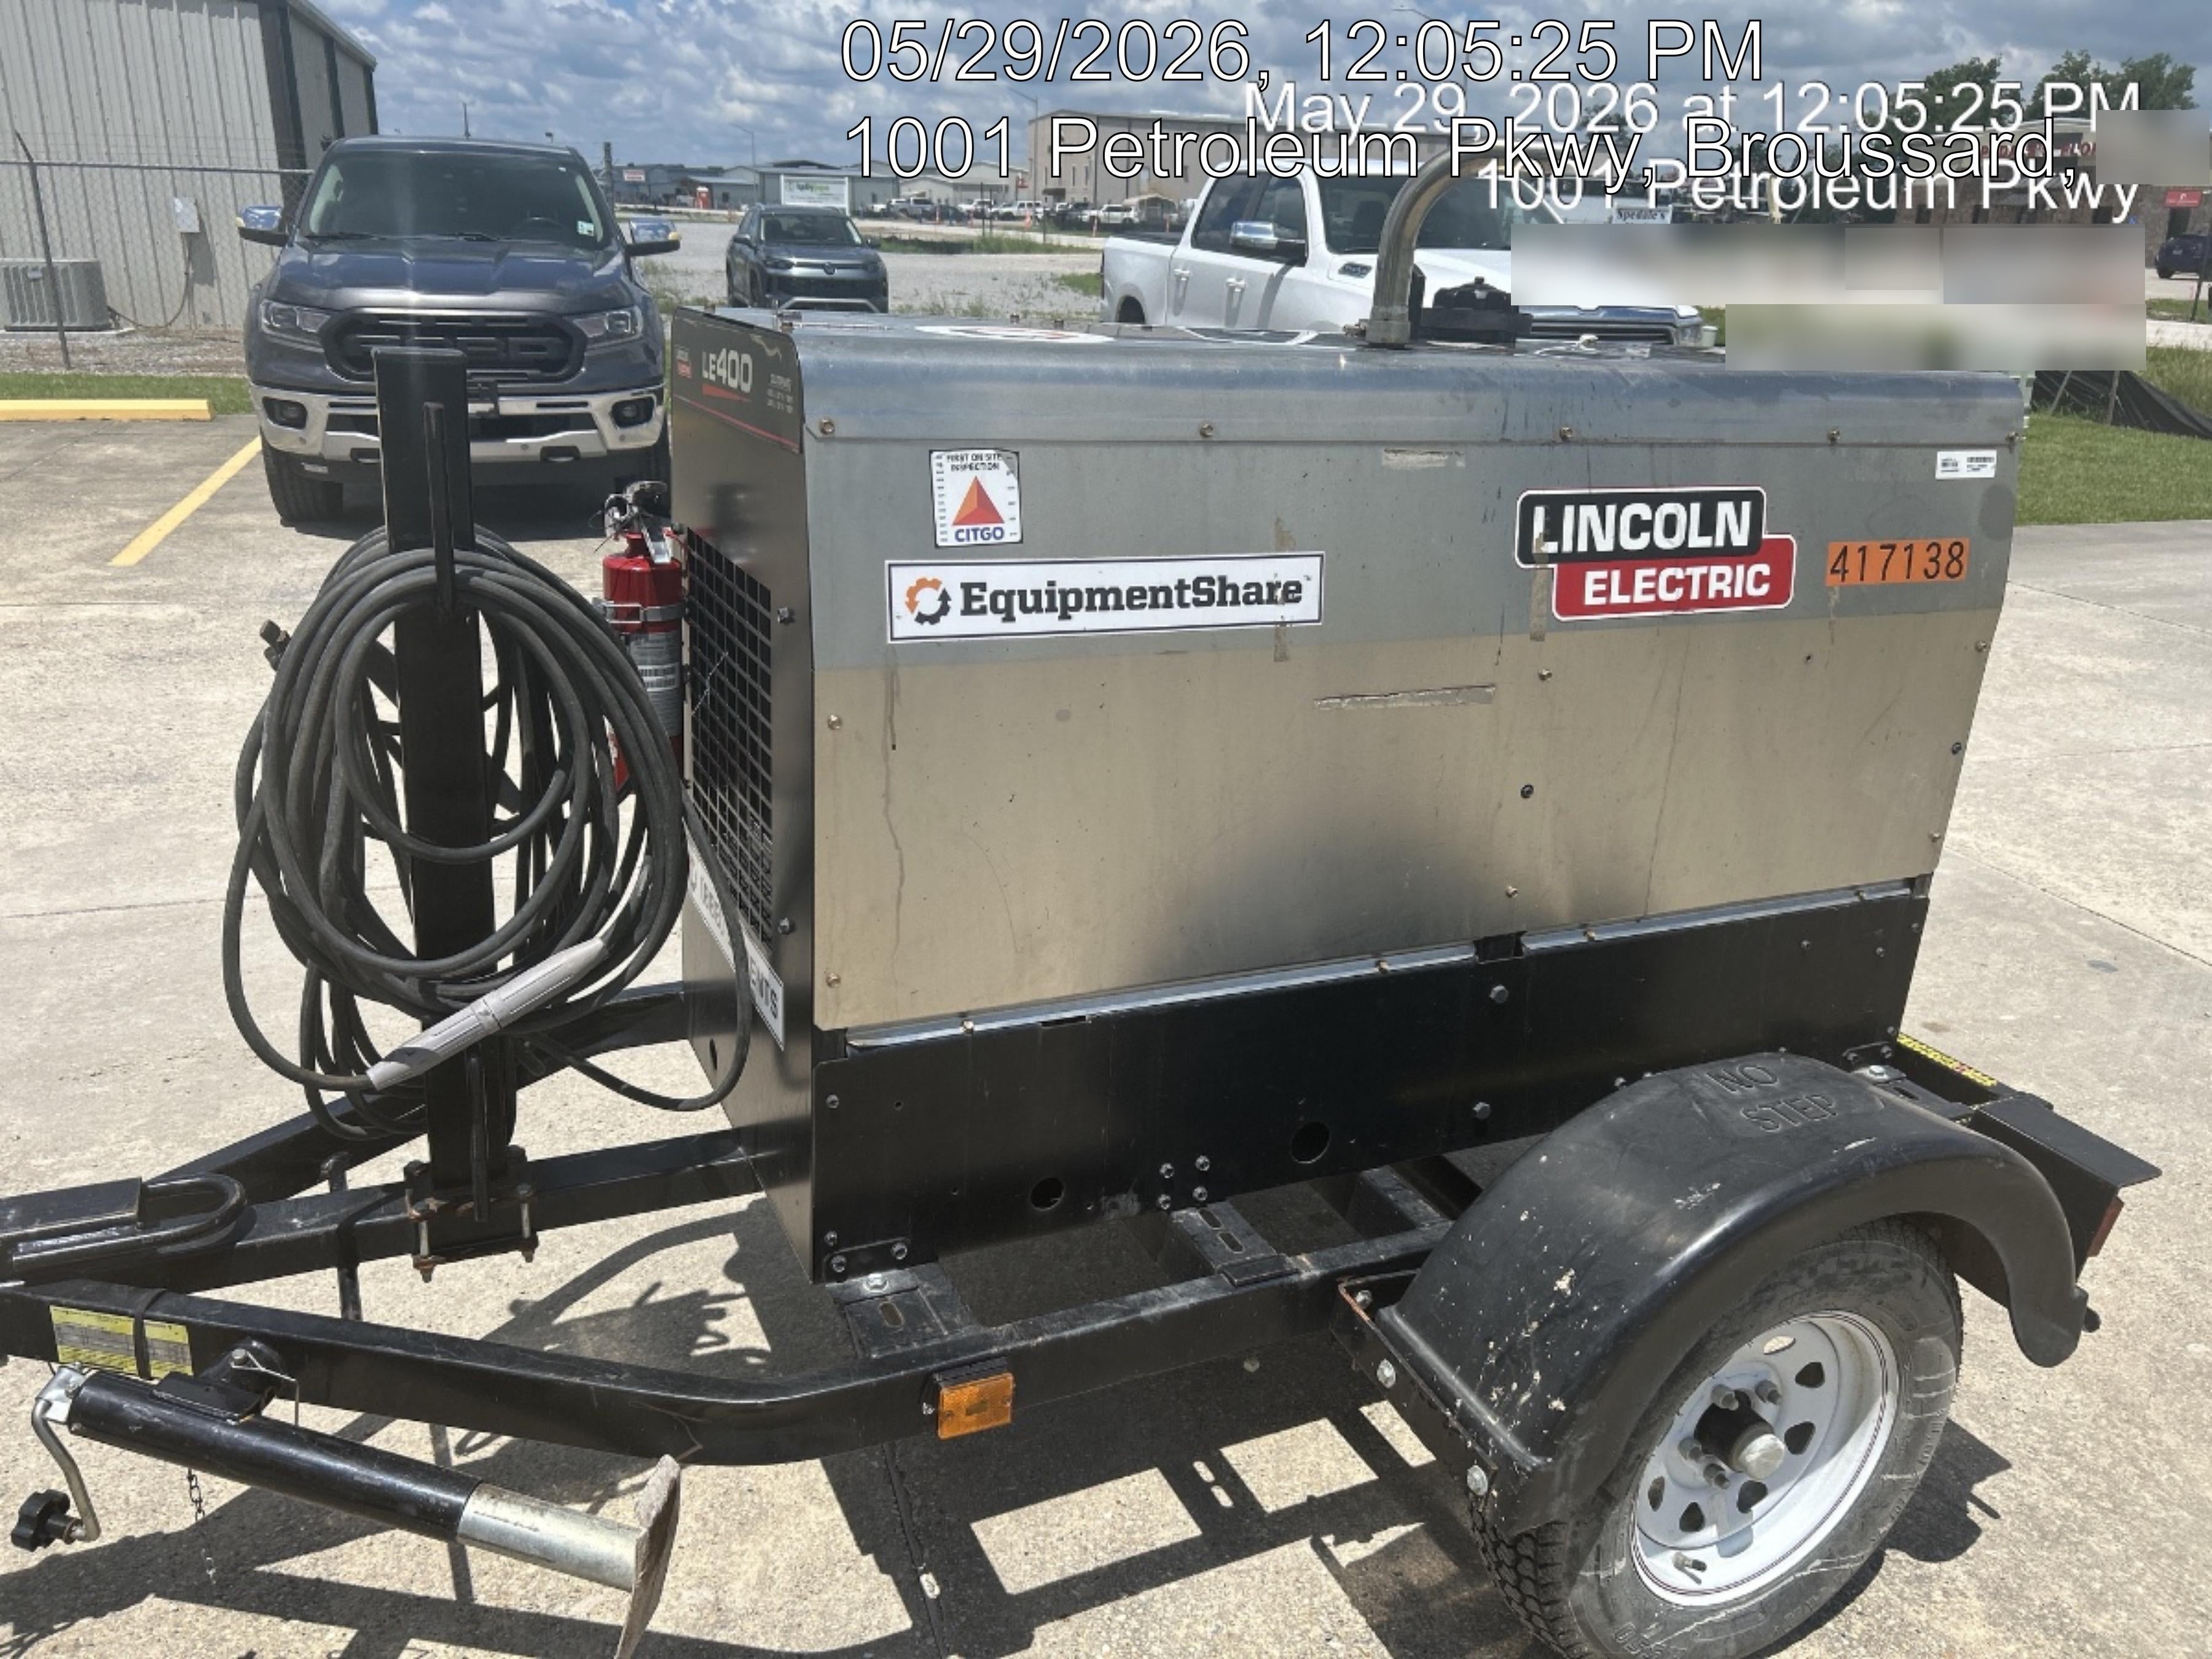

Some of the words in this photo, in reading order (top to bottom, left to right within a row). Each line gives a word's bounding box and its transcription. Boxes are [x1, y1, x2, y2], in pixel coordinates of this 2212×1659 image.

[702, 347, 753, 393] LE400
[955, 527, 1005, 542] CITGO
[1532, 501, 1752, 554] LINCOLN
[1830, 541, 1964, 582] 417138
[960, 575, 1303, 623] EquipmentShare
[1583, 563, 1770, 605] ELECTRIC
[1705, 1064, 1779, 1094] NO
[1740, 1094, 1838, 1132] STEP
